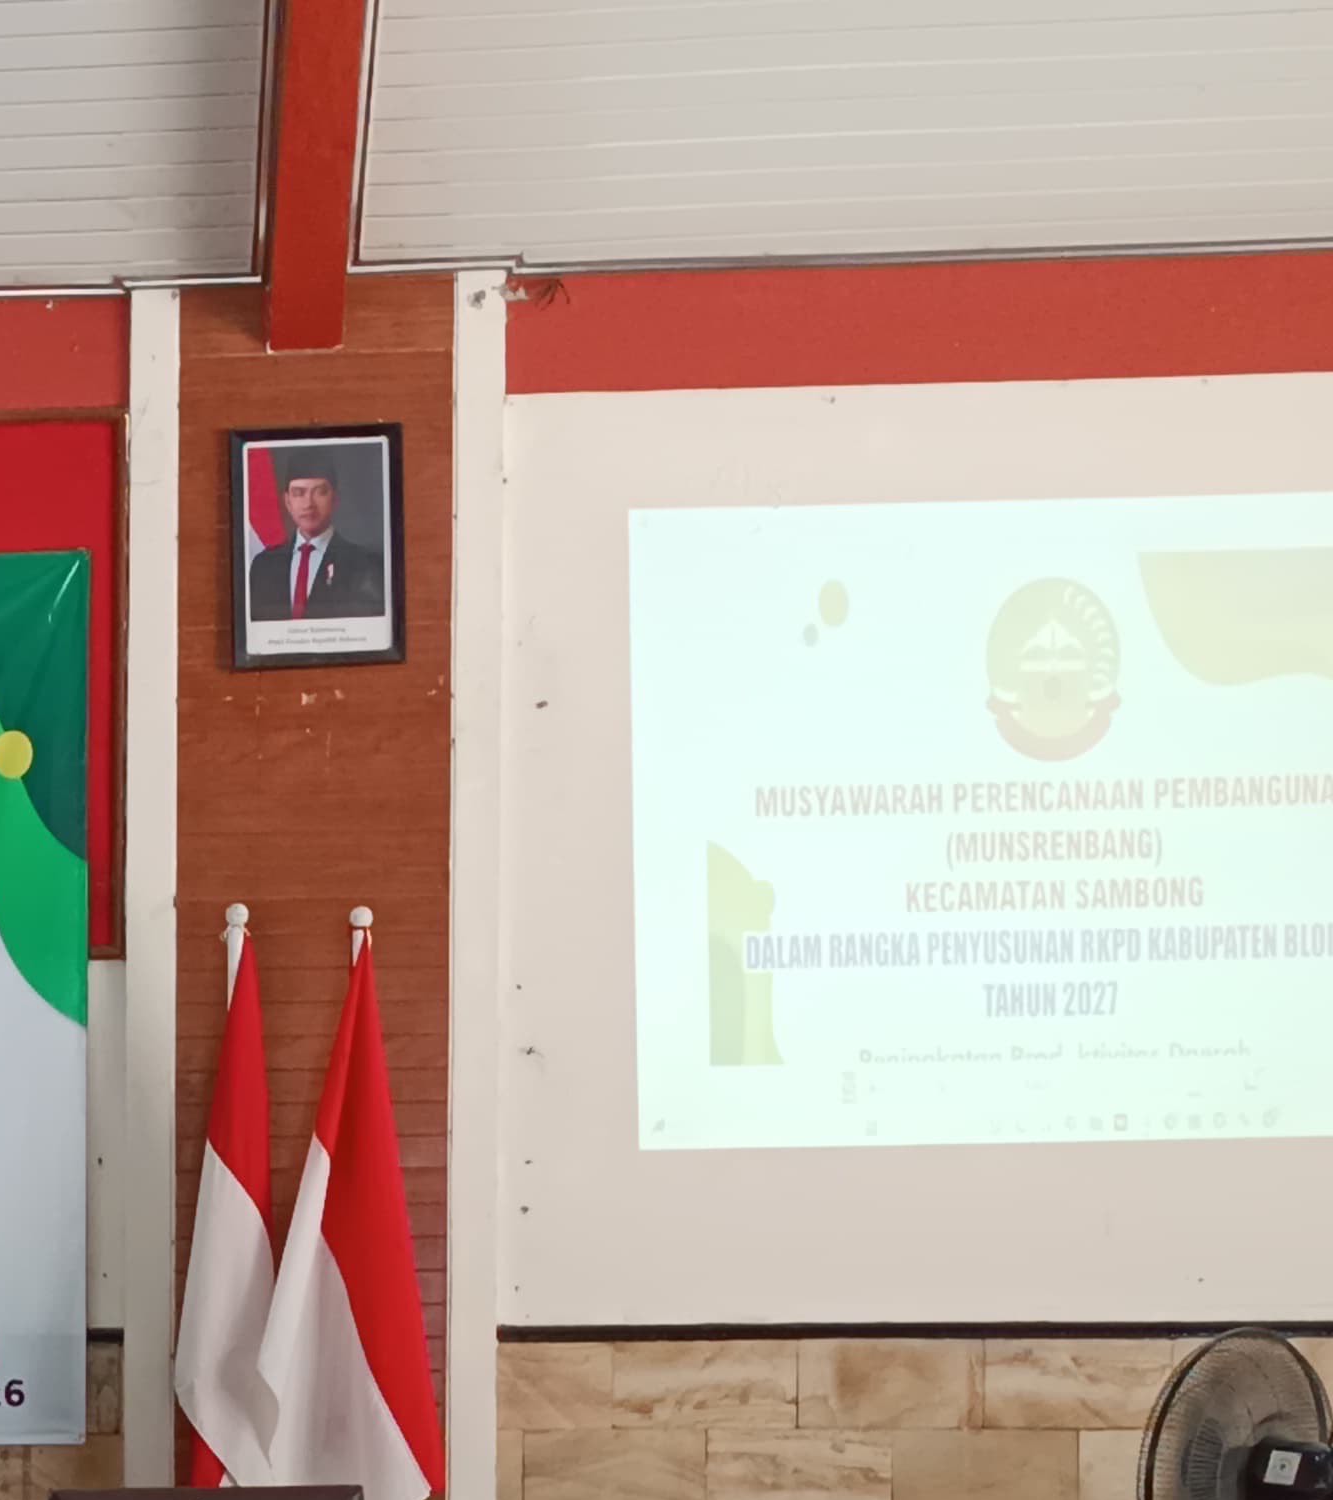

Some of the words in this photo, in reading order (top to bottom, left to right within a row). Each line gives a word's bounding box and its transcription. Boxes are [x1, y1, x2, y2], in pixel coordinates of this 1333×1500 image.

[754, 783, 943, 818] MUSYAWARAH
[953, 779, 1144, 814] PERENCANAAN
[946, 828, 1164, 872] (MUNSRENBANG)
[905, 879, 1066, 913] KECAMATAN
[1075, 875, 1205, 909] SAMBONG
[746, 933, 823, 969] DALAM
[828, 931, 921, 968] RANGKA
[927, 928, 1075, 966] PENYUSUNAN
[1080, 928, 1142, 964] RKPD
[1148, 924, 1277, 961] KABUPATEN
[982, 982, 1057, 1018] TAHUN
[1062, 980, 1119, 1017] 2027
